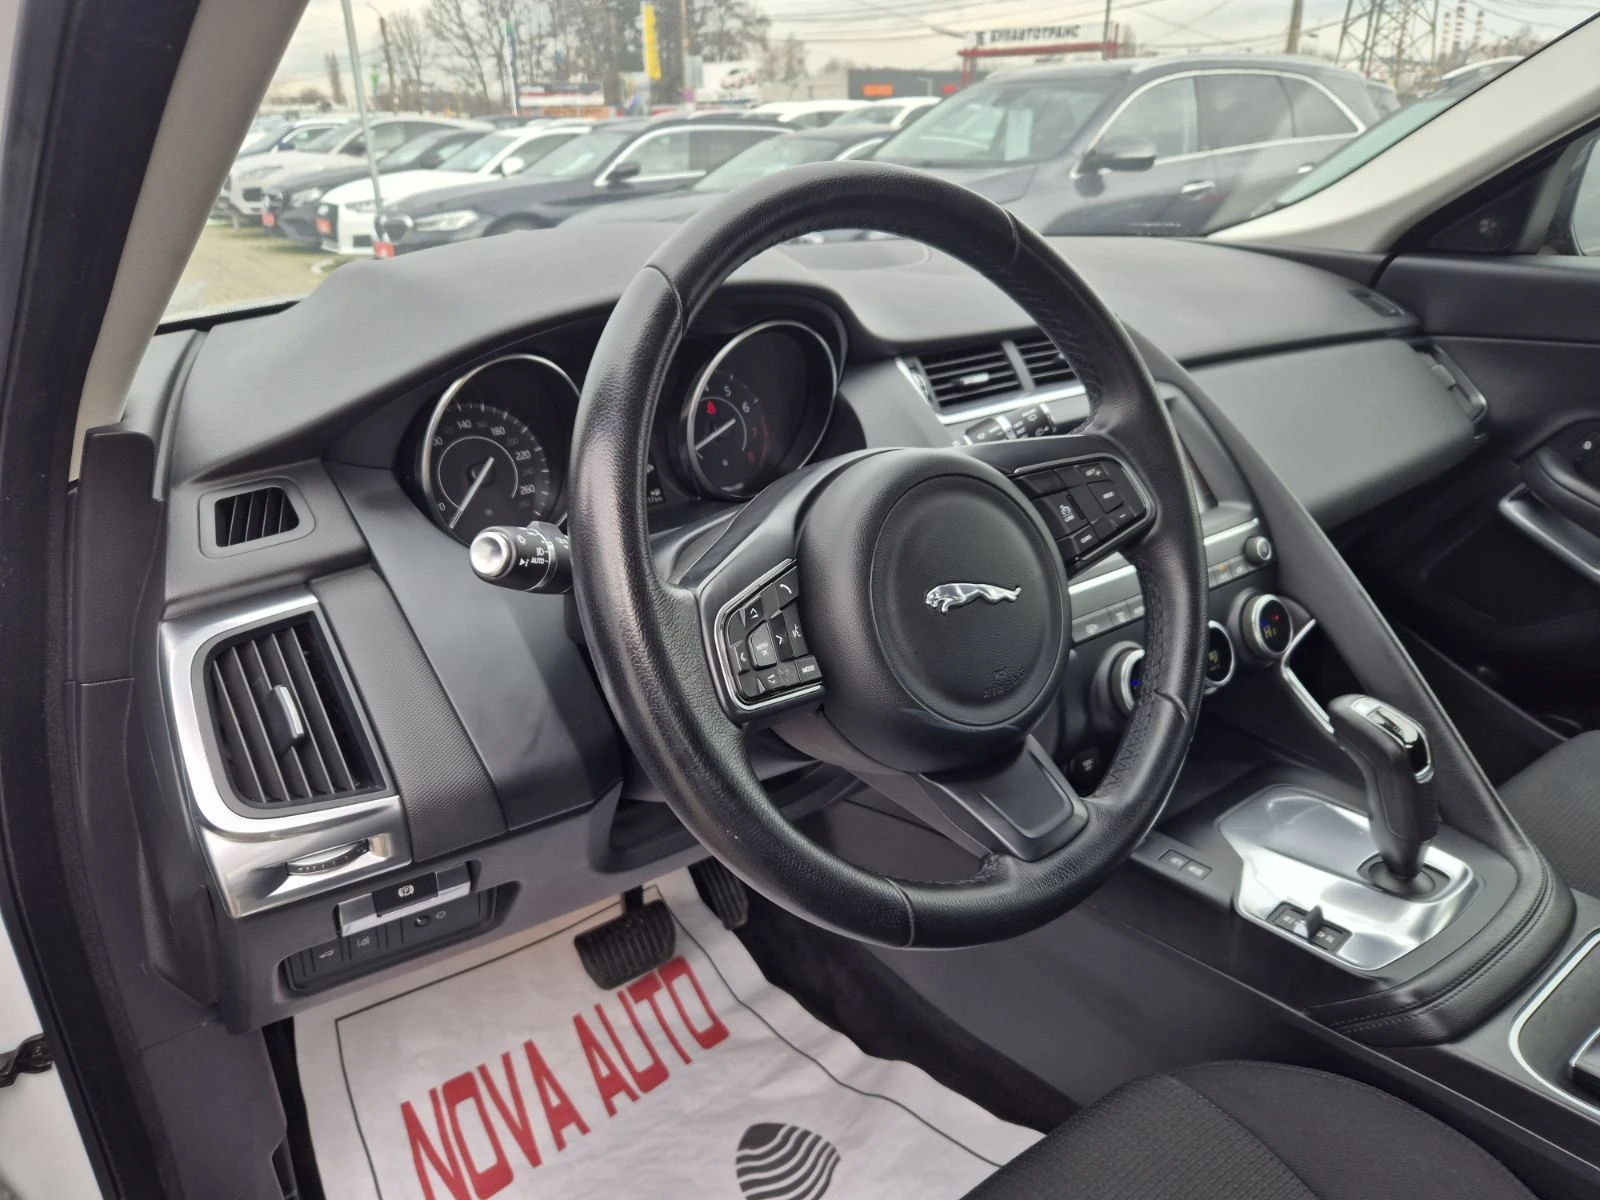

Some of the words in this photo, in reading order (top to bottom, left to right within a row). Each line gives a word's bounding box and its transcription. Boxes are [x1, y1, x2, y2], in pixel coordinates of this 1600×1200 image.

[724, 386, 732, 397] 5
[742, 402, 751, 413] 6
[457, 420, 472, 430] 140
[490, 426, 506, 436] 180
[515, 450, 532, 461] 220
[520, 485, 535, 495] 260
[439, 502, 446, 512] 0
[530, 557, 545, 565] AUTO
[802, 664, 816, 673] MODE
[401, 1040, 591, 1200] NOVA
[572, 955, 731, 1118] AUTO
